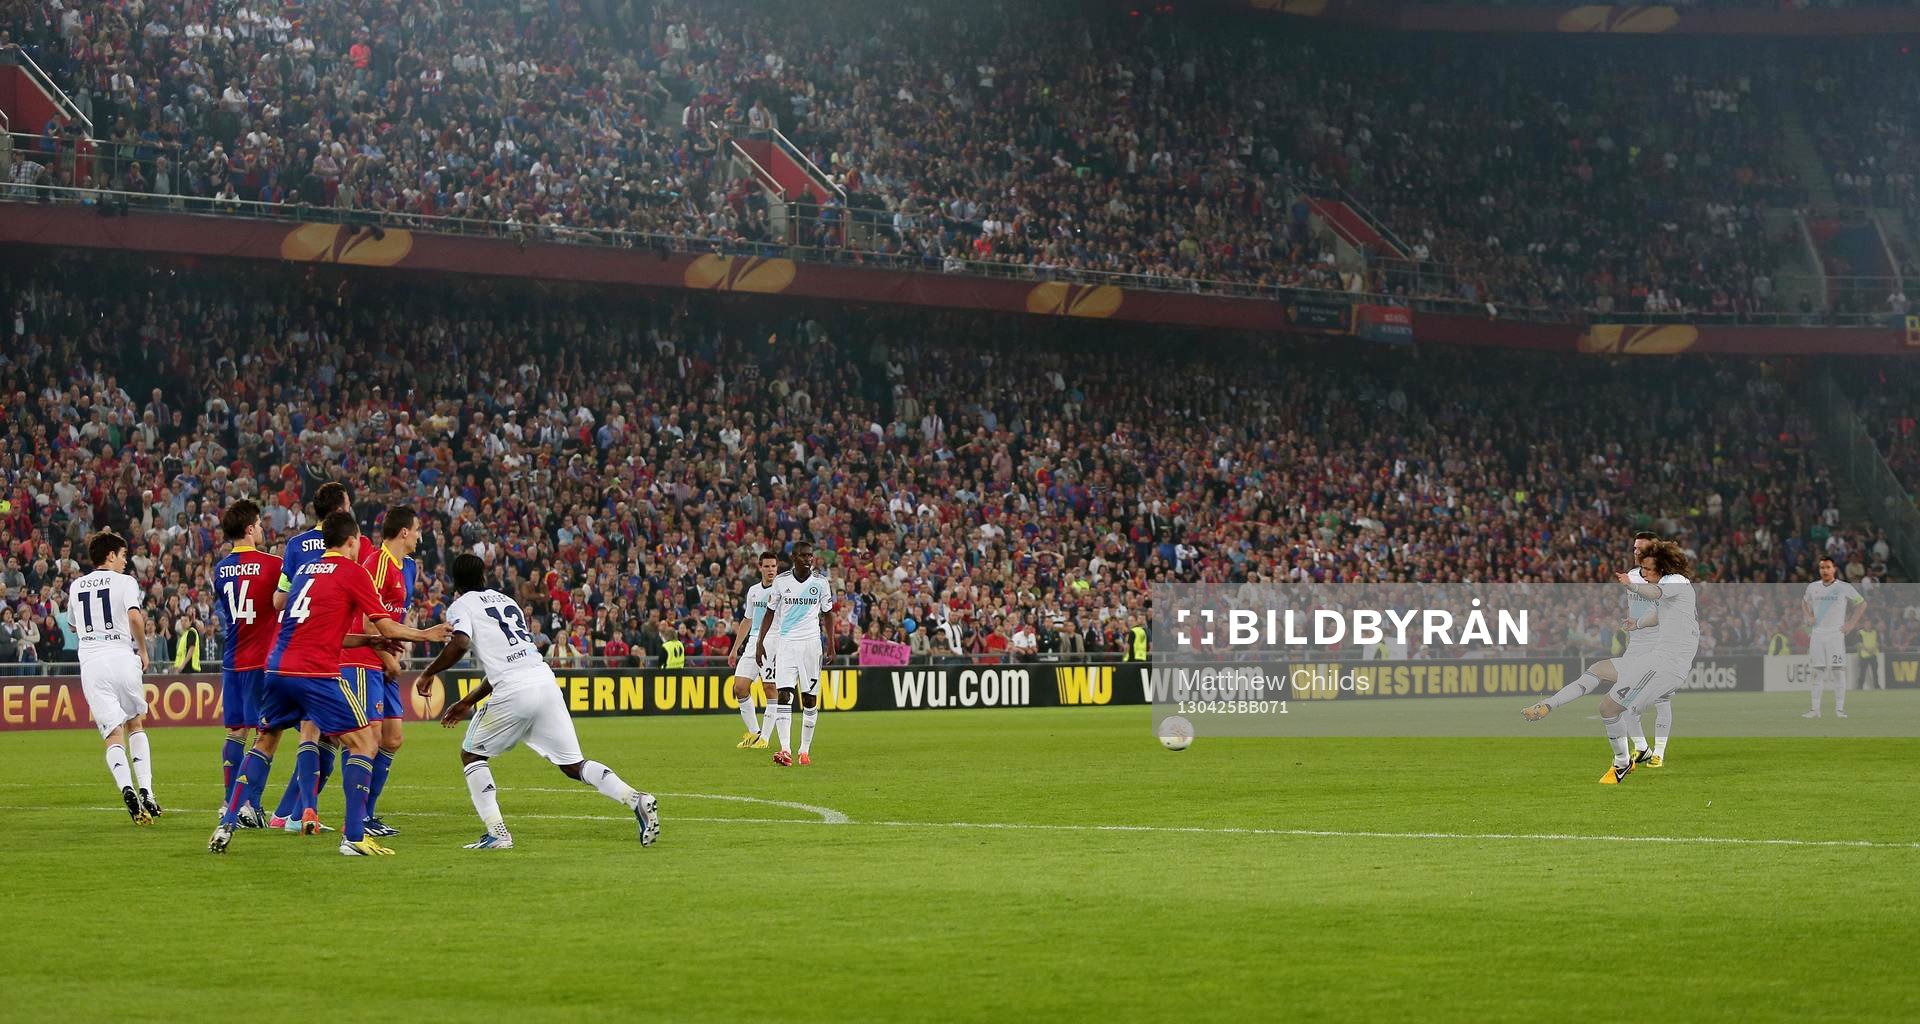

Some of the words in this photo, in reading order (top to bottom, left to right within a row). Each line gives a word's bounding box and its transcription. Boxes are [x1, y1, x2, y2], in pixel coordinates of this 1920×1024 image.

[302, 538, 327, 552] STRE
[220, 563, 260, 578] STOCKER
[305, 563, 338, 574] DEGEN
[80, 577, 111, 588] OSCAR
[223, 580, 257, 624] 14
[290, 578, 316, 623] 4
[78, 588, 114, 633] 11
[485, 605, 534, 646] 13
[501, 649, 528, 663] RIGHT
[863, 642, 903, 659] TORRES
[1354, 665, 1479, 695] WESTERN
[1483, 663, 1565, 694] UNION
[1786, 663, 1811, 683] UEF
[809, 678, 818, 690] 7
[1056, 666, 1113, 705] WU
[1616, 686, 1631, 700] 4
